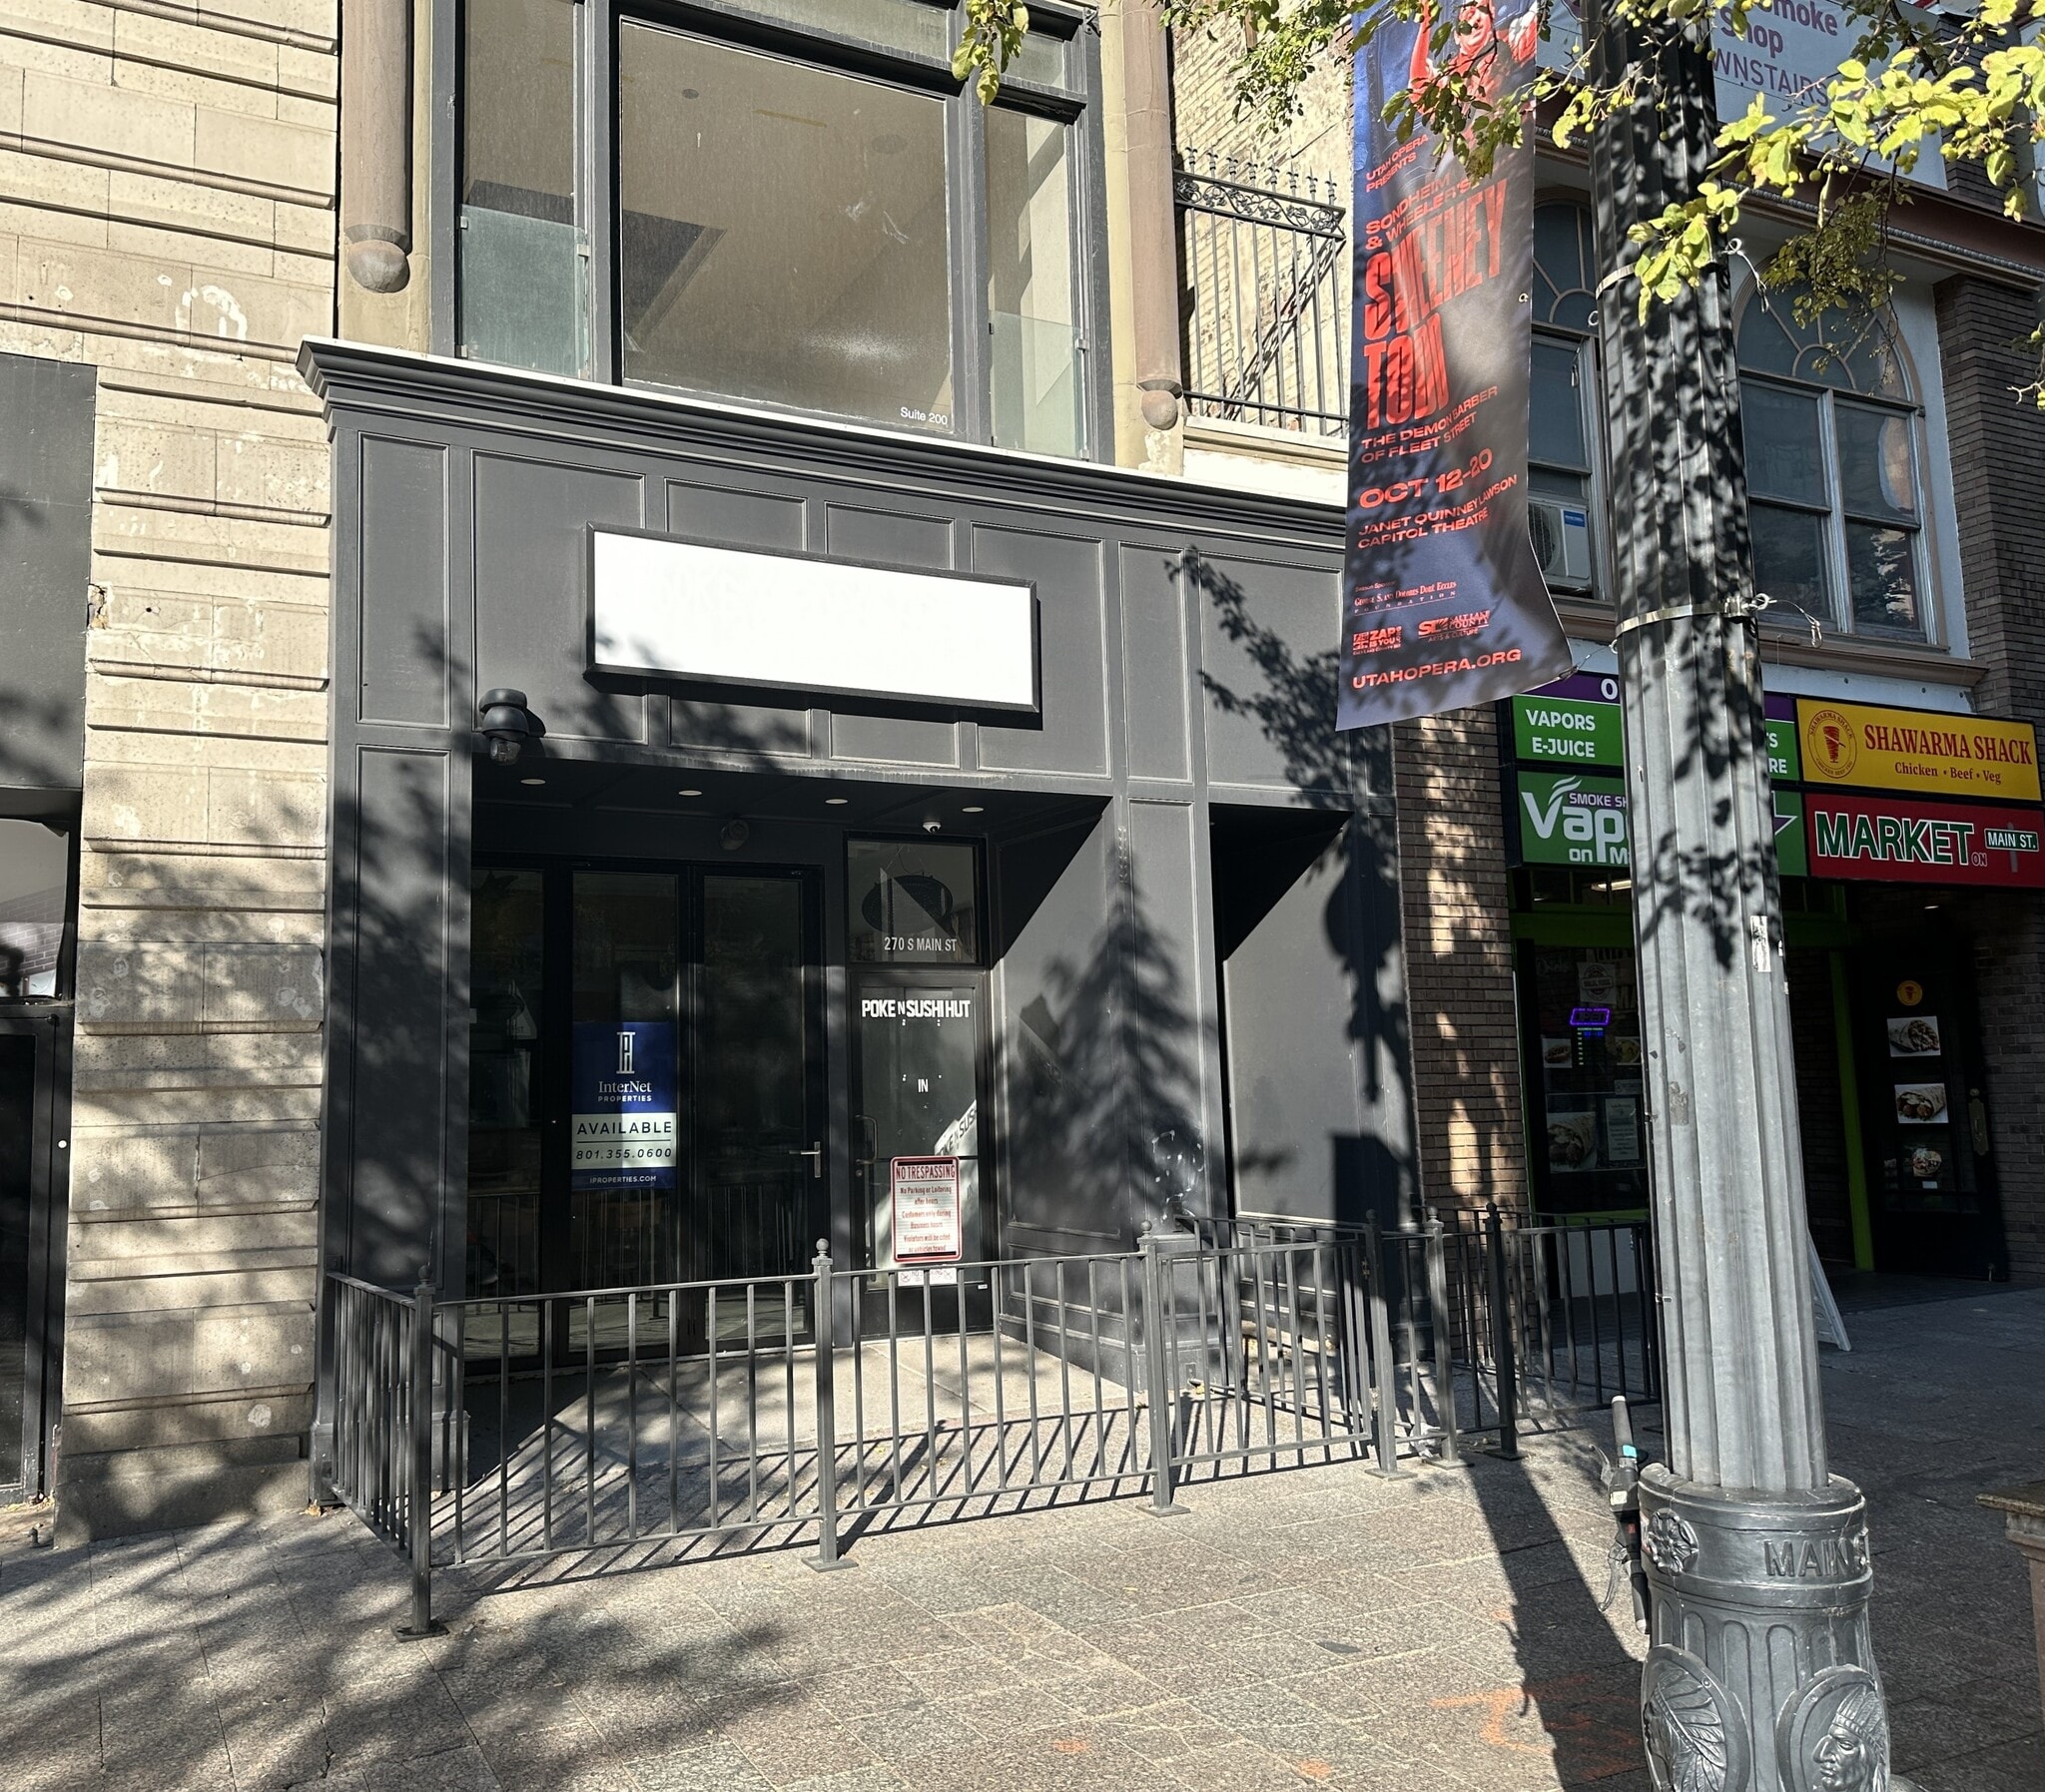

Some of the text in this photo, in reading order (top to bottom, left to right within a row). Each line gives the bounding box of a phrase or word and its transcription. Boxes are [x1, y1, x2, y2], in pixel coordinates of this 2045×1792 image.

[1366, 134, 1429, 181] UTAH OPERA
[1366, 152, 1417, 193] PRESENTS
[1365, 178, 1472, 250] & WHEELER'S
[1366, 172, 1451, 235] SONDHEIM
[1364, 178, 1508, 340] SWEENEY
[1364, 312, 1450, 430] TODD
[901, 407, 948, 425] Suite 200
[1361, 385, 1498, 450] THE DEMON BARBER
[1361, 411, 1478, 464] OF FLEET STREET
[1358, 474, 1518, 536] JANET QUINNEY LAWSON
[1359, 477, 1429, 509] OCT
[1358, 507, 1490, 549] CAPITOL THEATRE
[1352, 649, 1522, 689] UTAHOPERA.ORG
[1526, 709, 1596, 731] VAPORS
[1532, 737, 1596, 759] E-JUICE
[1863, 724, 2033, 766] SHAWARMA SHACK
[1895, 762, 2001, 785] Chicken Beef Veg
[1569, 793, 1628, 808] SMOKE SH
[1521, 792, 1629, 863] Vap
[1814, 811, 2037, 867] MARKET ON MAIN ST.
[1569, 847, 1630, 865] on M
[885, 936, 957, 951] 270 S MAIN ST
[861, 999, 971, 1018] POKE N SUSHI HUT
[599, 1080, 652, 1093] InterNet
[918, 1078, 929, 1092] IN
[577, 1122, 671, 1134] AVAILABLE
[576, 1148, 671, 1160] 801.355.0600
[896, 1165, 955, 1180] NO TRESPASSING
[908, 1186, 925, 1195] Parking
[1763, 1539, 1849, 1577] MAIN
